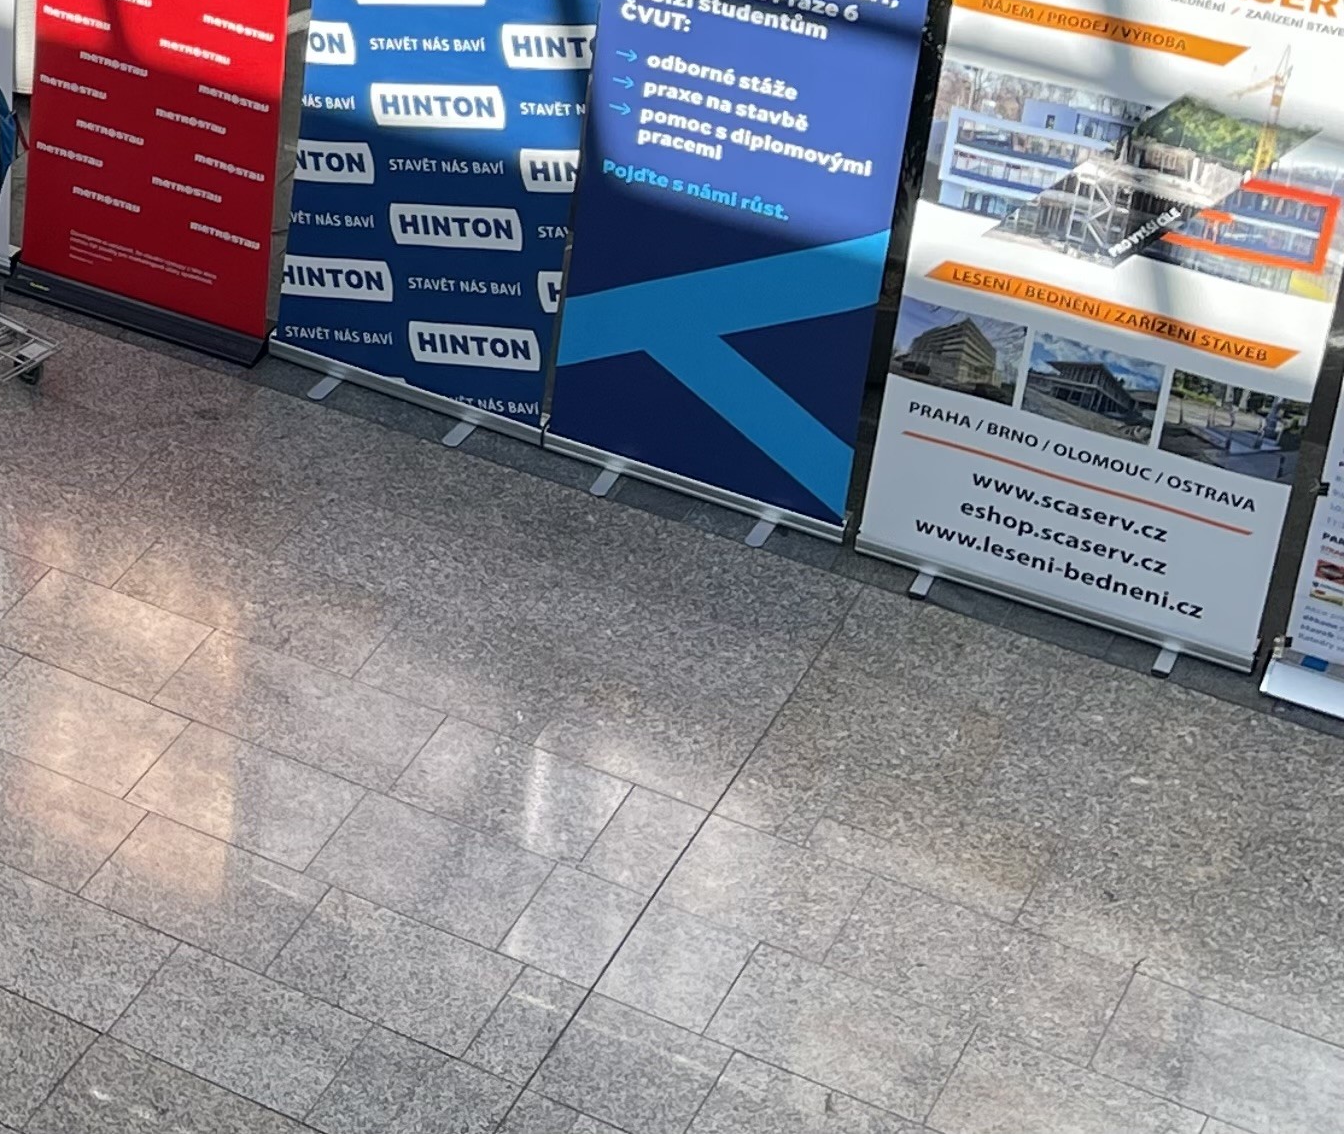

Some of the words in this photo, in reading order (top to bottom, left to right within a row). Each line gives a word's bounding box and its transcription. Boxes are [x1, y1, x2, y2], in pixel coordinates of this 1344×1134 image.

[621, 0, 693, 35] ČVUT:
[843, 3, 860, 23] 6
[1046, 11, 1110, 34] PRODEJ
[1121, 24, 1188, 52] VÝROBA
[1245, 8, 1305, 29] ZAŘÍZENÍ
[370, 35, 419, 52] STAVĚT
[422, 35, 450, 52] NÁS
[453, 36, 486, 53] BAVÍ
[646, 53, 736, 86] odborné
[739, 74, 799, 102] stáže
[380, 92, 497, 118] HINTON
[642, 80, 704, 107] praxe
[706, 95, 732, 114] na
[735, 101, 809, 133] stavbě
[637, 128, 724, 161] pracemi
[639, 106, 712, 135] pomoc
[715, 125, 728, 141] s
[730, 127, 873, 178] diplomovými
[603, 158, 669, 189] Pojďte
[672, 178, 684, 192] s
[687, 182, 738, 208] námi
[740, 196, 790, 222] růst.
[399, 213, 514, 241] HINTON
[285, 323, 330, 340] STAVĚT
[334, 327, 360, 344] NÁS
[362, 328, 394, 346] BAVÍ
[417, 330, 532, 361] HINTON
[1113, 308, 1198, 343] ZAŘÍZENÍ
[1200, 333, 1268, 363] STAVEB
[908, 400, 972, 431] PRAHA
[986, 419, 1040, 450] BRNO
[1052, 442, 1152, 483] OLOMOUC
[1166, 473, 1257, 513] OSTRAVA
[971, 472, 1169, 544] www.scaserv.cz
[959, 500, 1169, 577] eshop.scaserv.cz
[914, 517, 1205, 620] www.leseni-bedneni.cz
